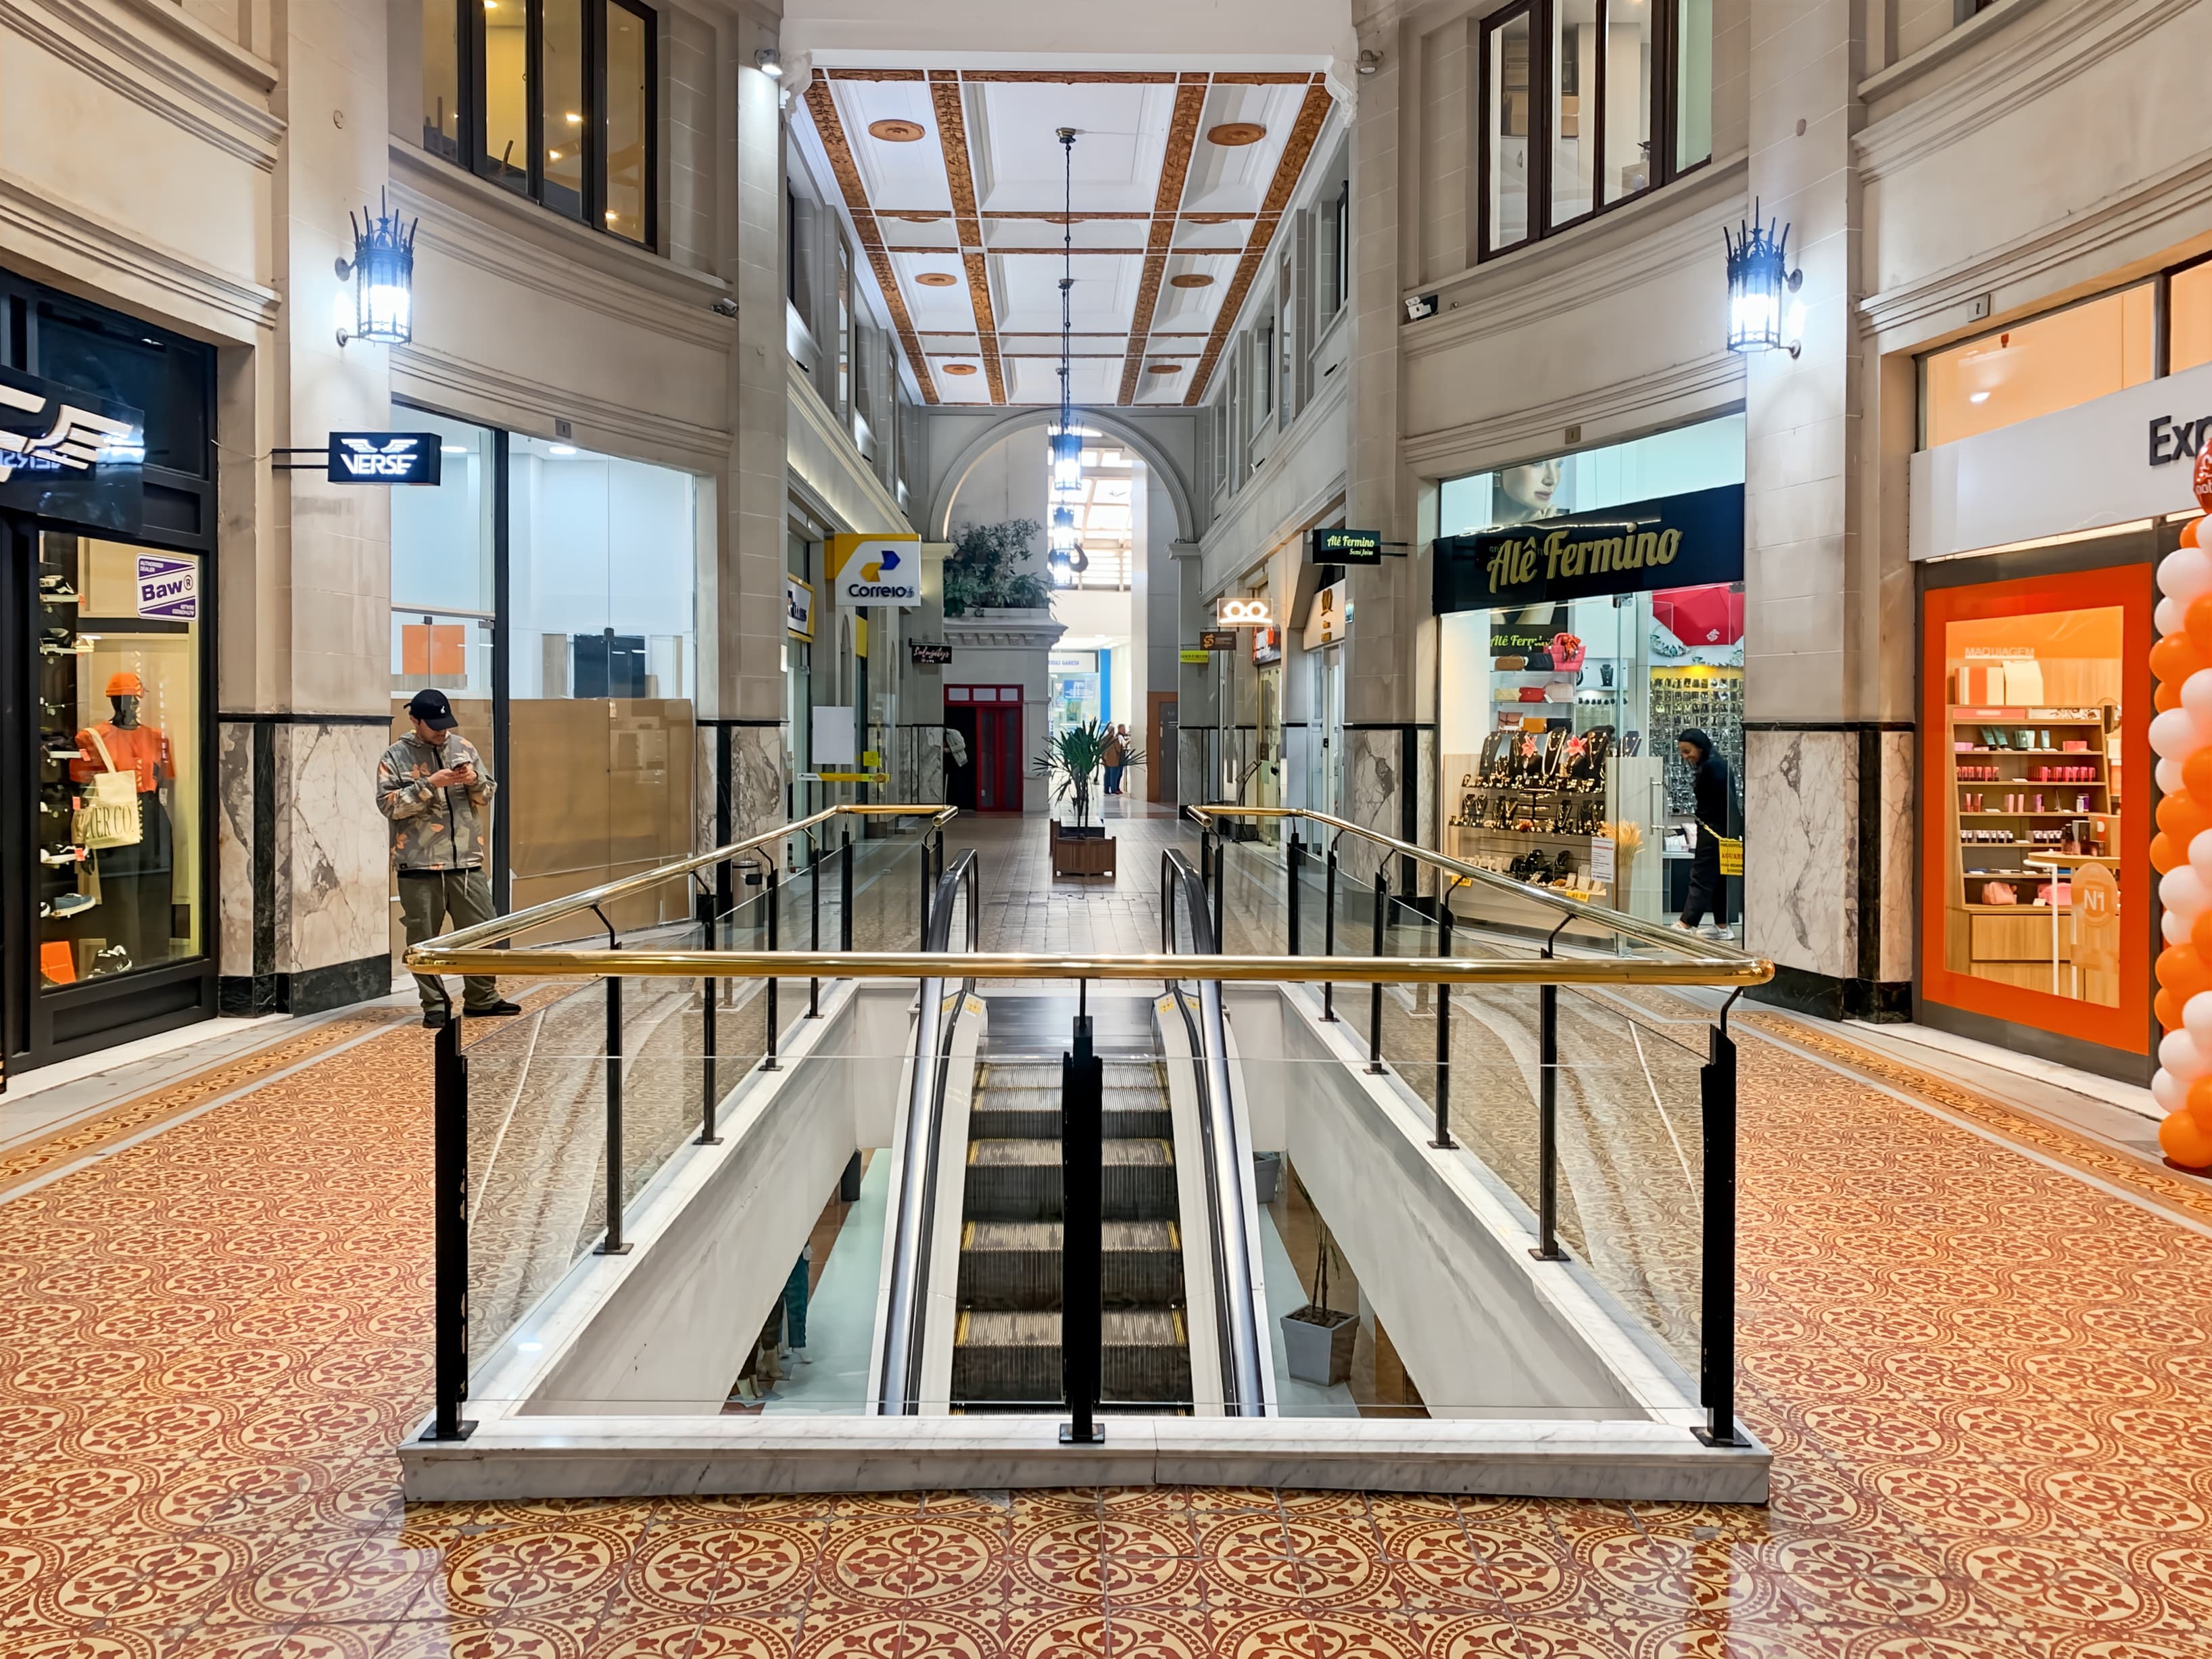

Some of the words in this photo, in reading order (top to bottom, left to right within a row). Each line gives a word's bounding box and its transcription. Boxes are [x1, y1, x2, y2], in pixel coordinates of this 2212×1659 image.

[341, 454, 418, 475] VERSE
[1327, 535, 1342, 548] Alê
[1343, 535, 1374, 548] Fermino
[1487, 536, 1538, 594] Alê
[1543, 522, 1682, 579] Fermino
[848, 583, 915, 598] Correios
[1491, 634, 1508, 648] Alê
[1965, 647, 2034, 659] MAQUIAGEM
